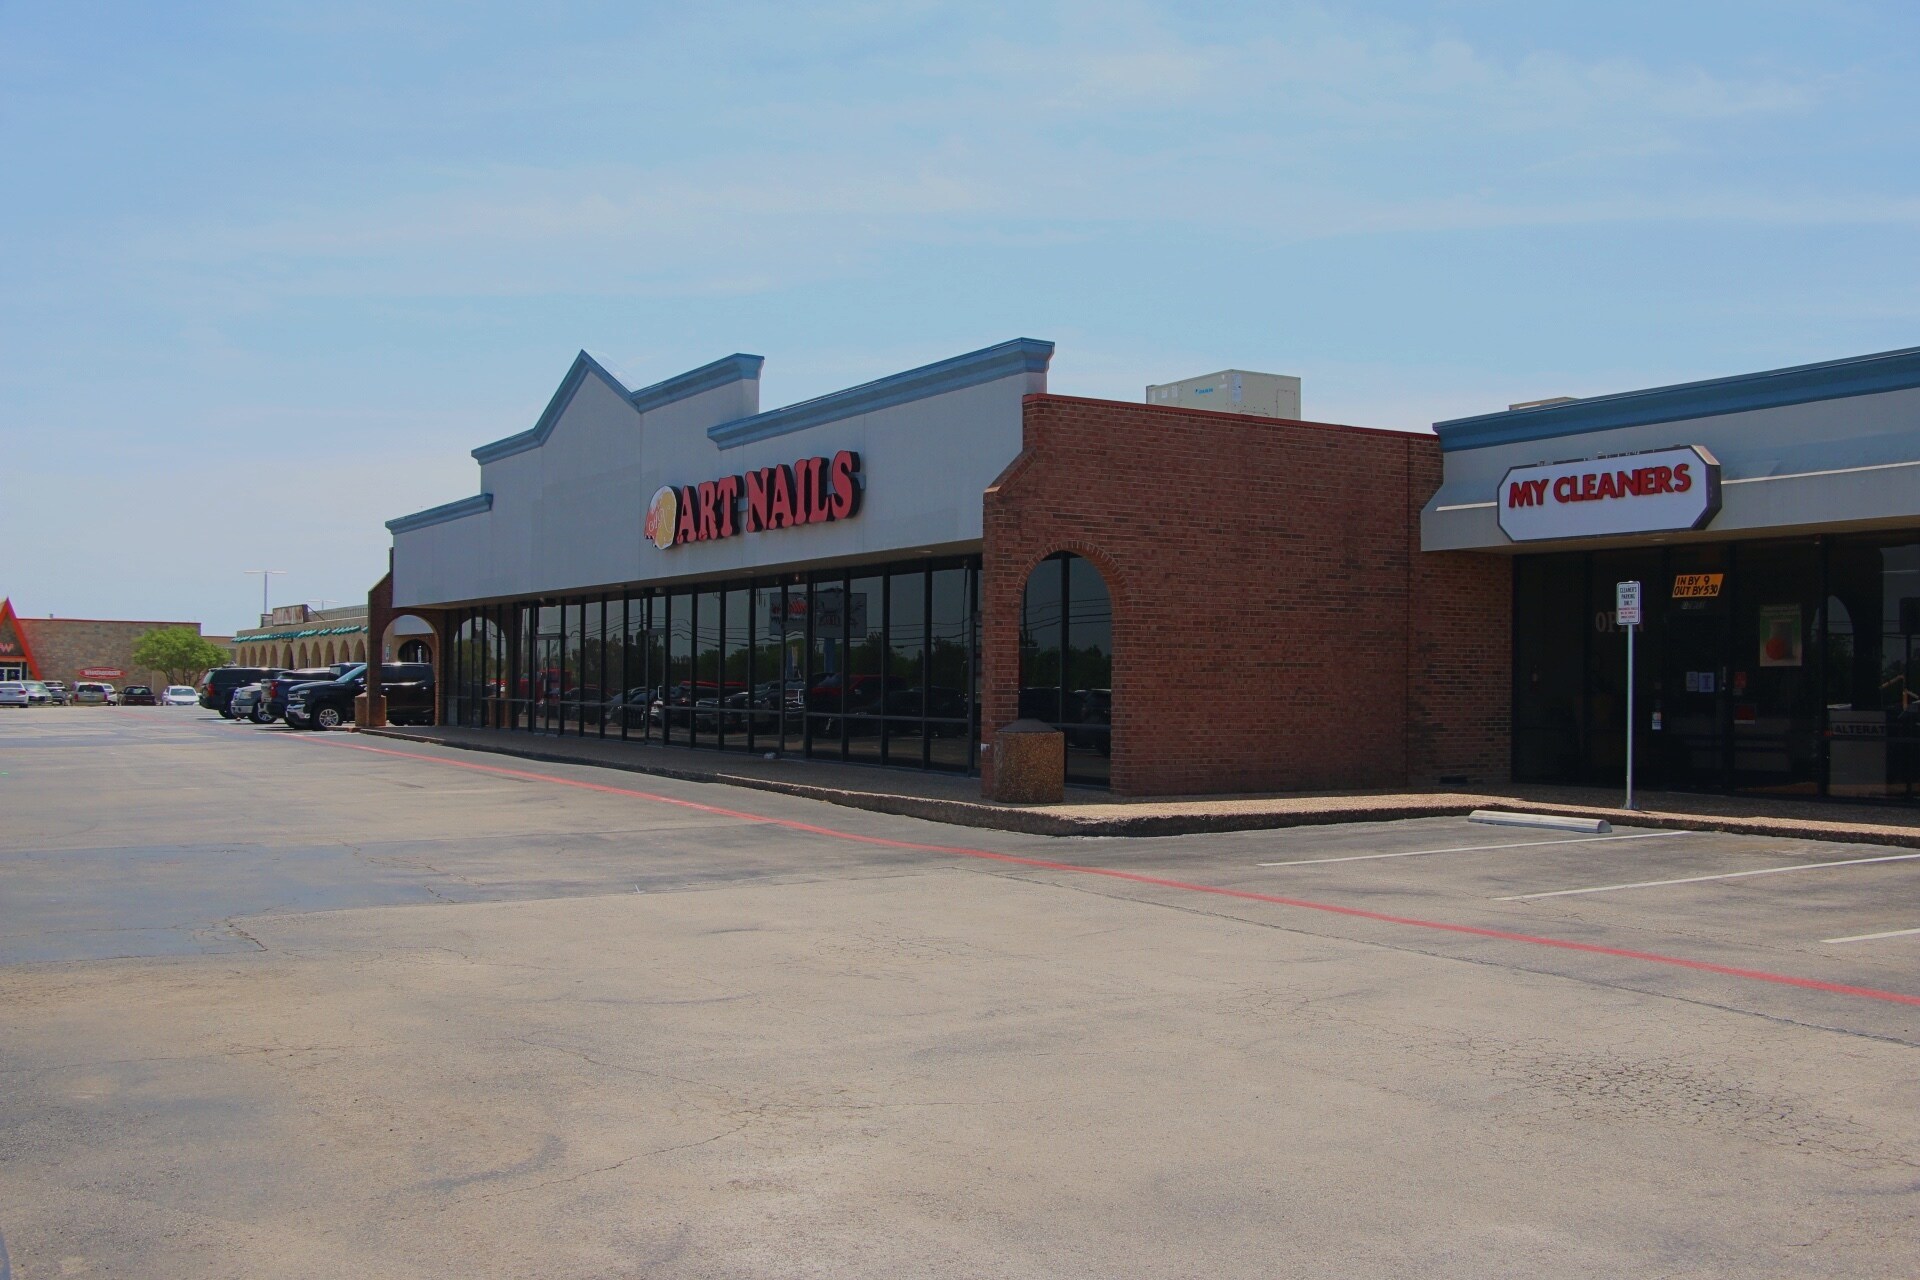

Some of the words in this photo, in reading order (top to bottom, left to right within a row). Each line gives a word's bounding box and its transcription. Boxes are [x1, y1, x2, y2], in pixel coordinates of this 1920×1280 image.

[676, 475, 742, 545] ART
[745, 450, 859, 533] NAILS
[1508, 478, 1549, 508] MY
[1553, 463, 1692, 503] CLEANERS
[1674, 586, 1691, 596] OUT
[1692, 585, 1703, 595] BY
[1677, 577, 1686, 585] IN
[1688, 576, 1700, 585] BY
[1704, 575, 1710, 585] 9
